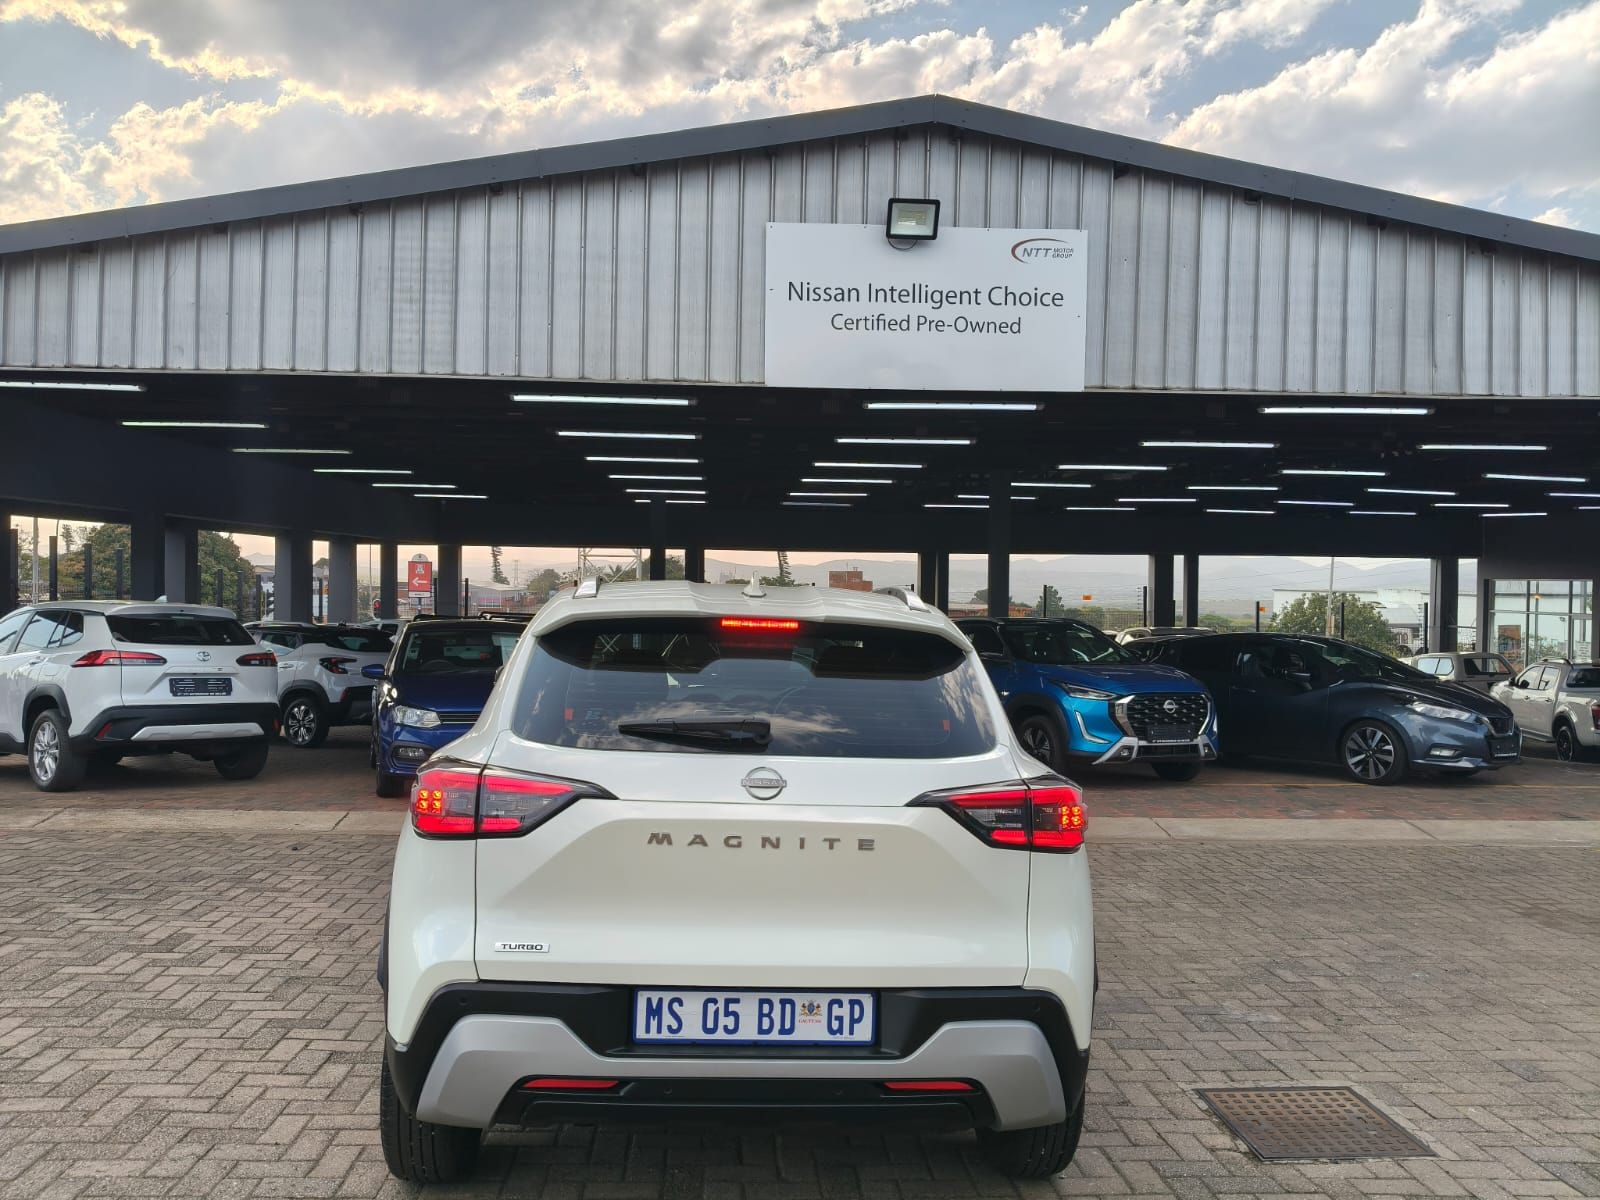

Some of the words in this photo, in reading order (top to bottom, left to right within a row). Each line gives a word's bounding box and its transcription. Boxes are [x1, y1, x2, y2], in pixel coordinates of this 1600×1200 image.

[1022, 248, 1052, 257] NTT
[787, 281, 860, 302] Nissan
[868, 283, 982, 310] Intelligent
[988, 286, 1064, 307] Choice
[831, 313, 910, 332] Certified
[917, 315, 1021, 334] Pre-Owned
[647, 832, 875, 851] MAGNITE
[501, 943, 544, 951] TURBO
[645, 997, 684, 1035] MS
[701, 997, 741, 1035] 05
[757, 997, 796, 1036] BD
[827, 998, 865, 1036] GP
